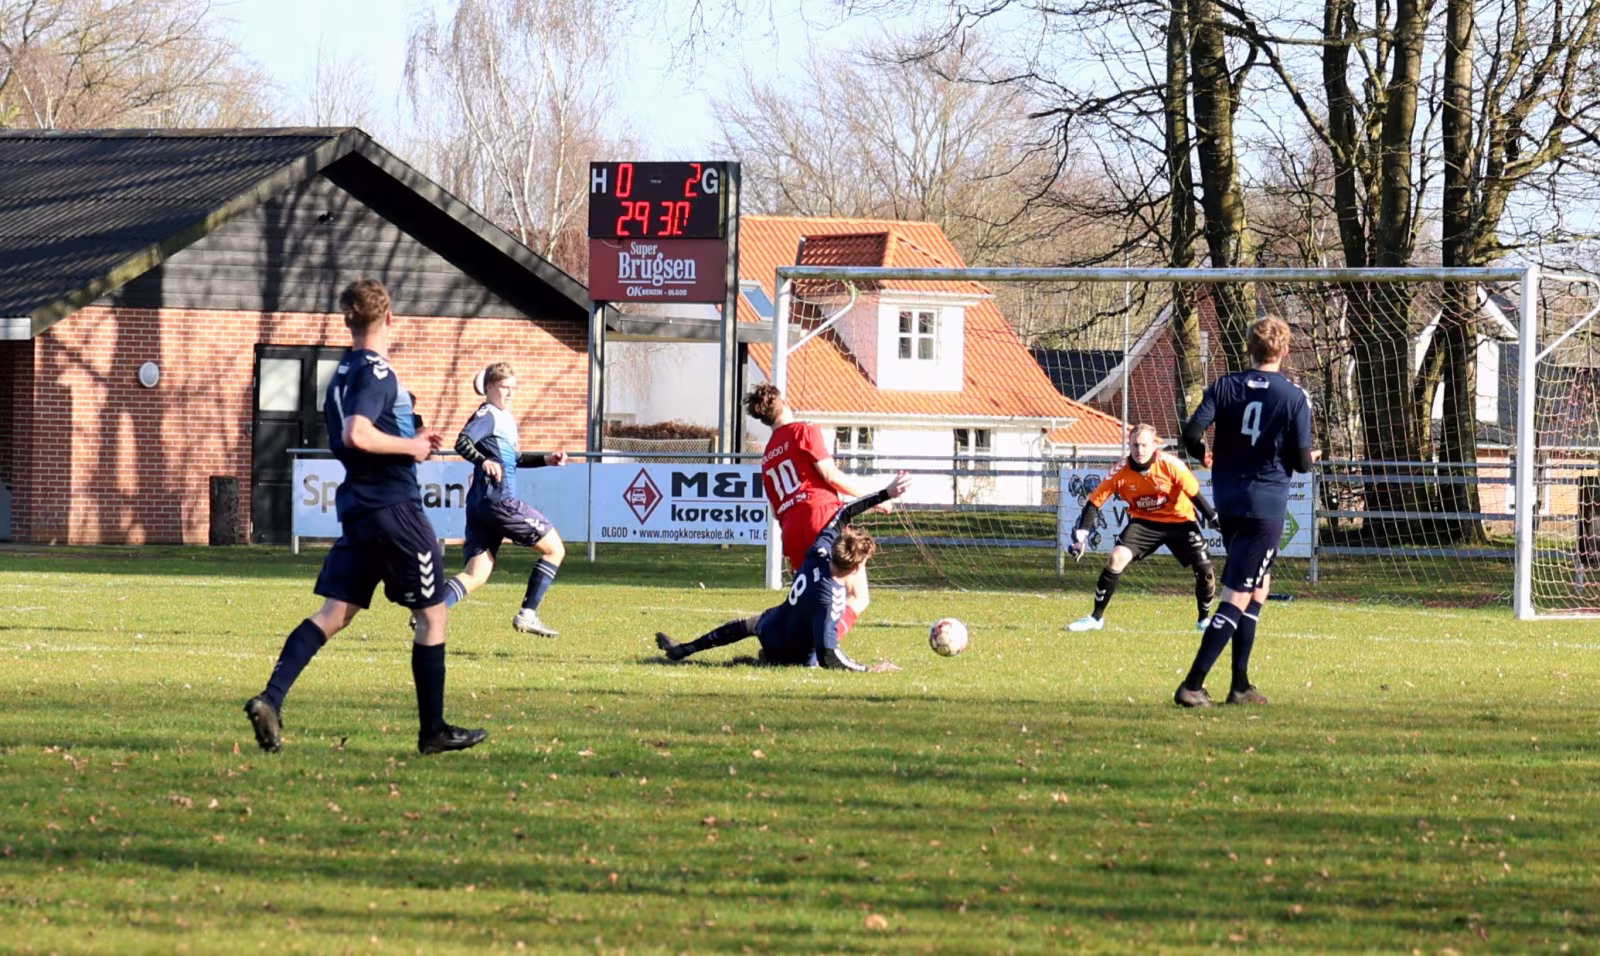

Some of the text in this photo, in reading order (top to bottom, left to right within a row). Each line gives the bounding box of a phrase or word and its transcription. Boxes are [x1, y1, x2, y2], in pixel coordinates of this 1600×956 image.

[591, 163, 719, 198] H 0 2 G
[616, 201, 650, 236] 29
[630, 241, 658, 259] Super
[618, 251, 696, 286] Brugsen
[1241, 401, 1263, 446] 4
[765, 459, 802, 502] 10
[671, 504, 768, 523] køresko
[601, 526, 628, 538] ØLGOD
[639, 527, 735, 541] www.mogkkoreskole.dk
[789, 573, 807, 606] 8
